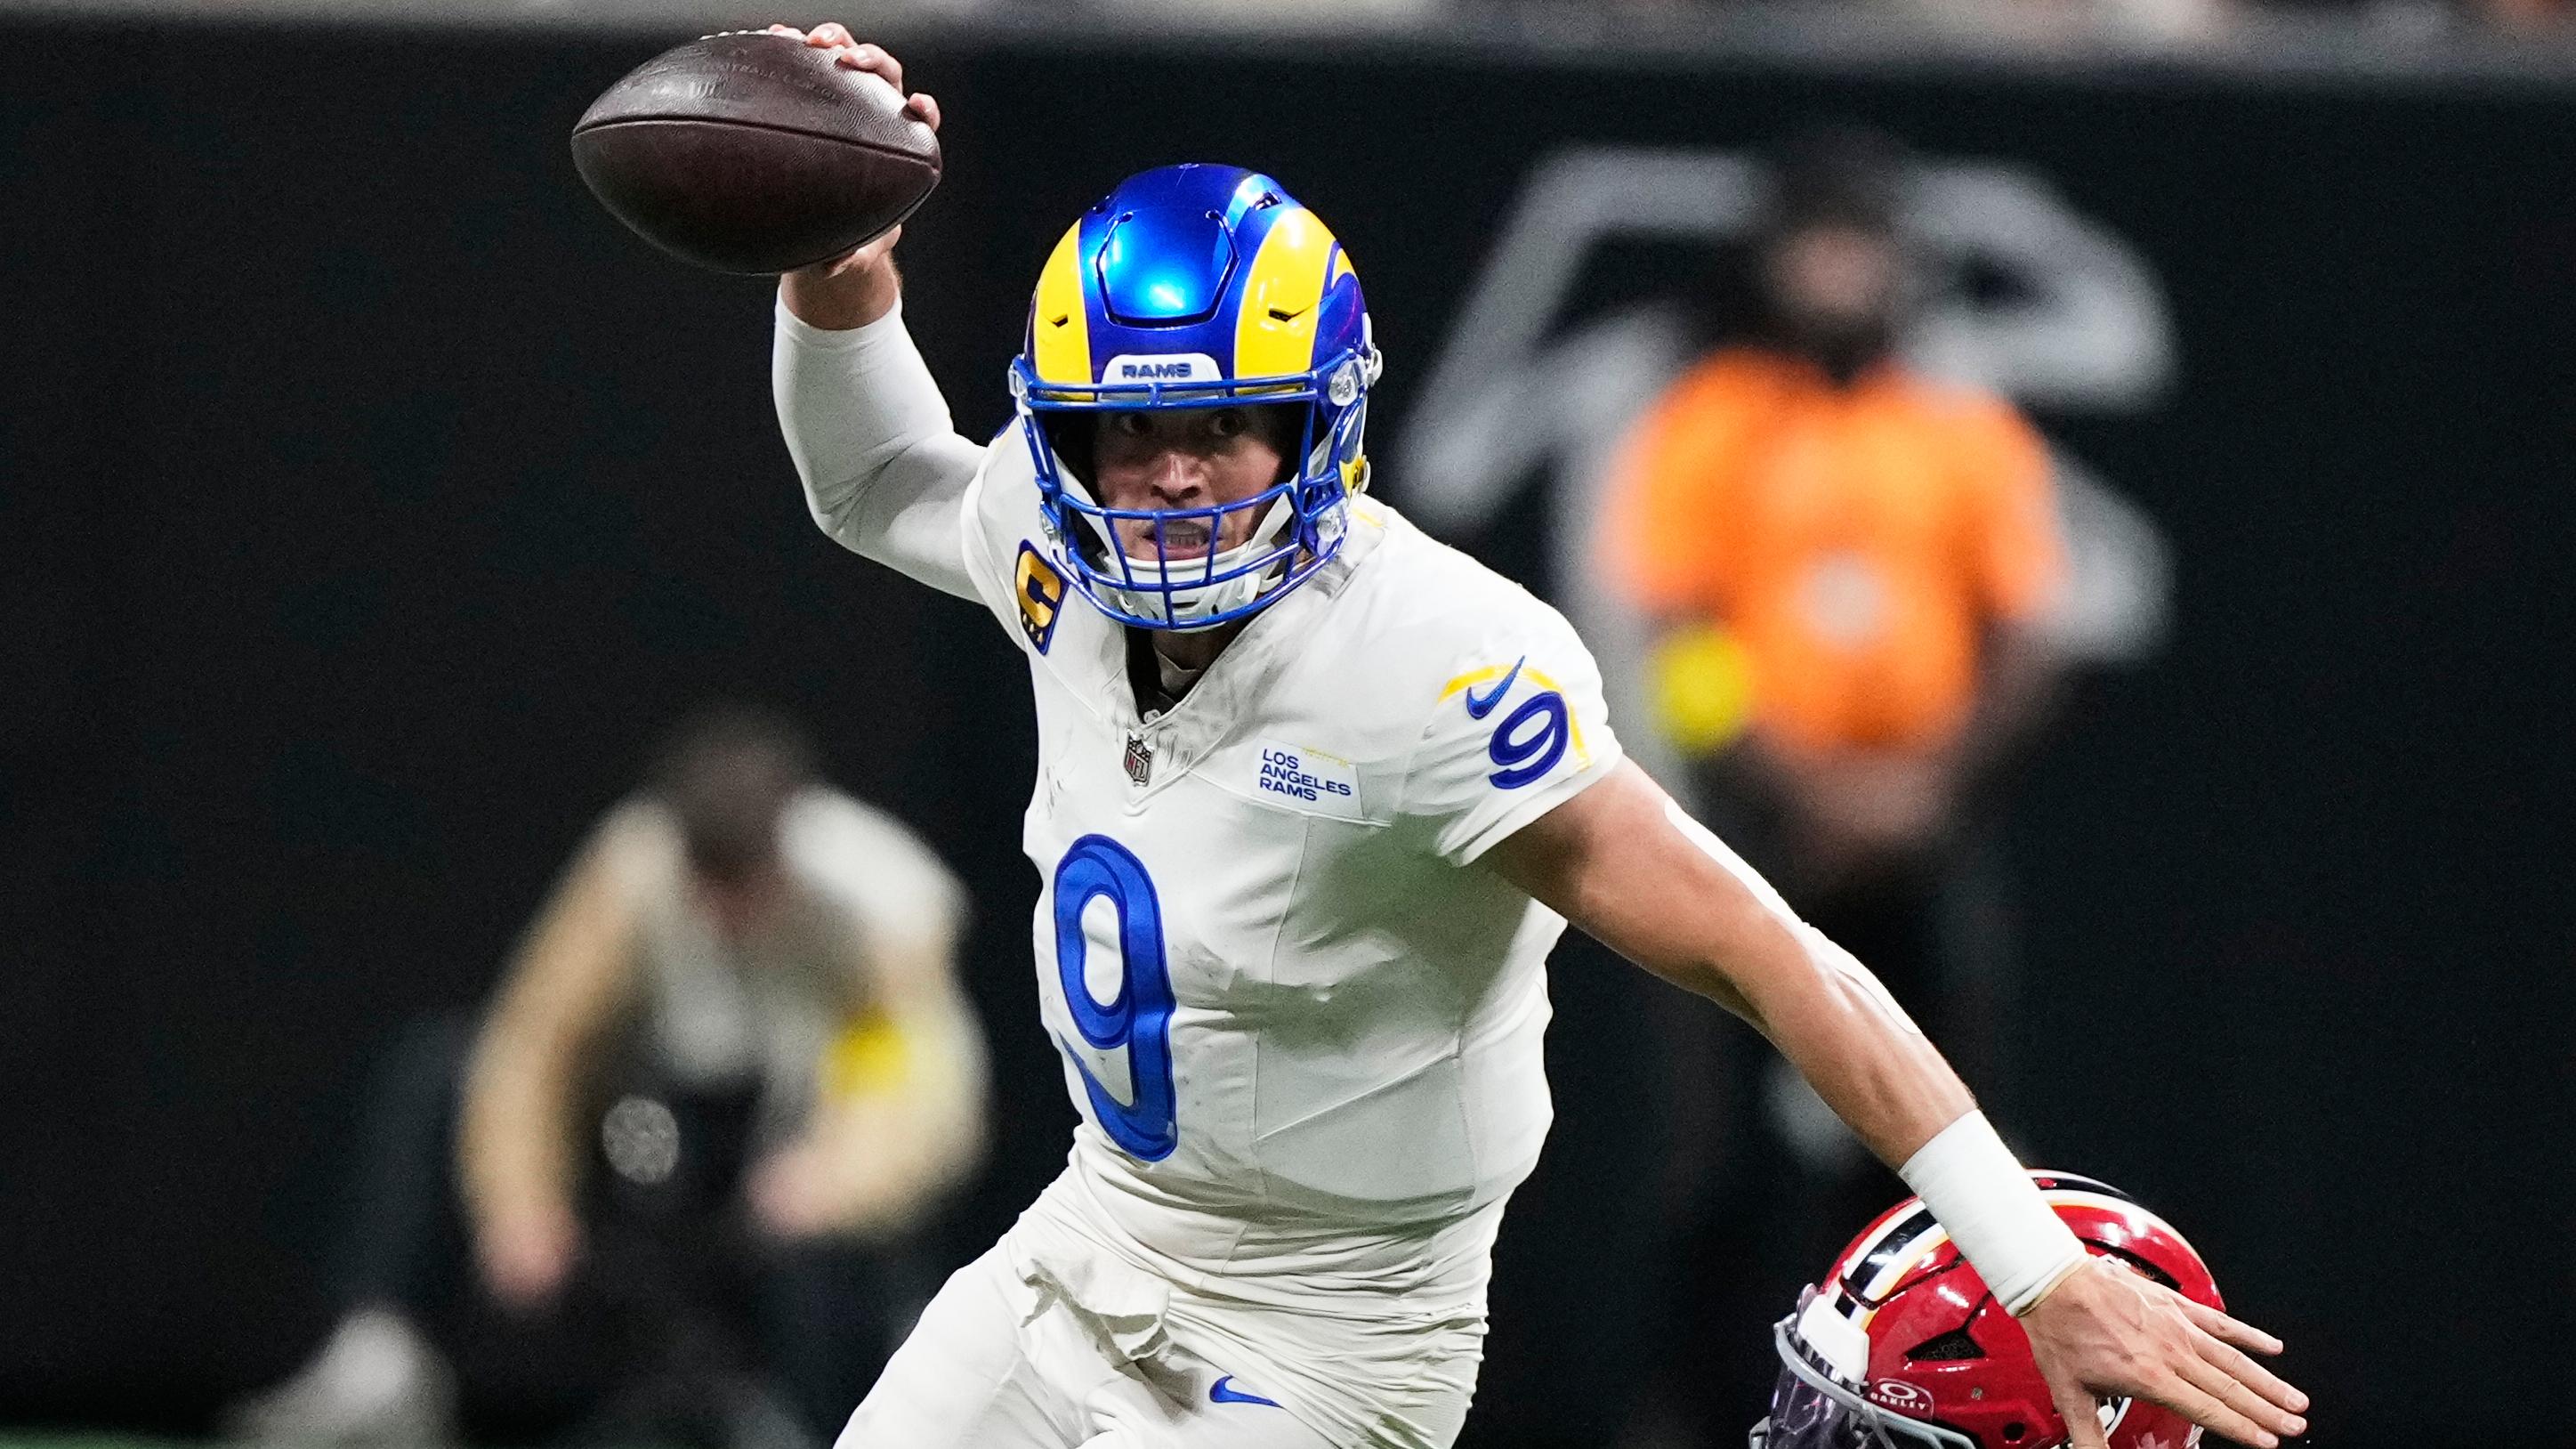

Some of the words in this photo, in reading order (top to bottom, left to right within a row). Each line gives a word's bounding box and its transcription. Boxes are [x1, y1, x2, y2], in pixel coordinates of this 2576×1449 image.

[1122, 362, 1191, 378] RAMS
[1016, 550, 1061, 627] C
[1489, 691, 1568, 789] 9
[1263, 749, 1299, 769] LOS
[1260, 764, 1352, 796] ANGELES
[1260, 777, 1317, 801] RAMS
[1054, 833, 1178, 1162] 9
